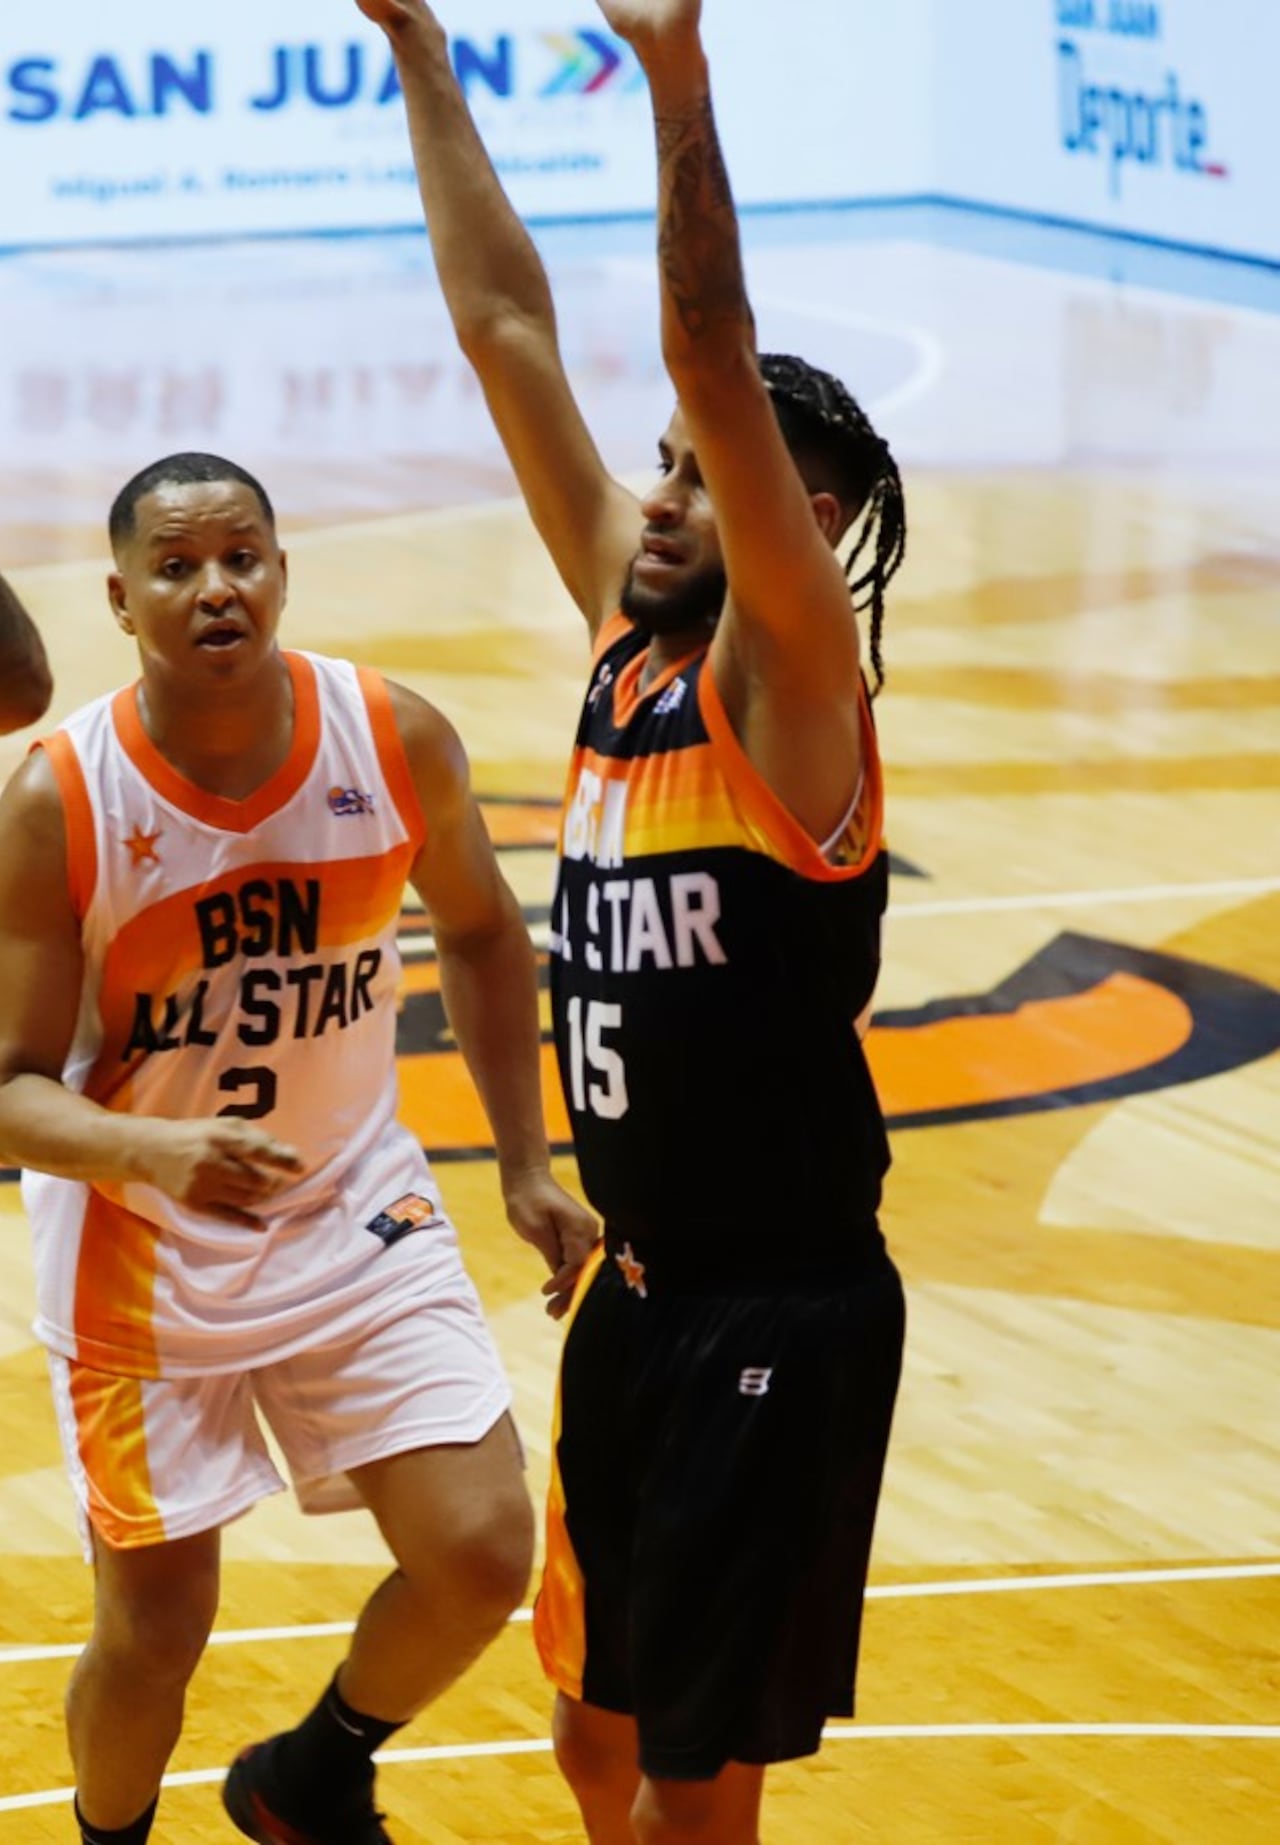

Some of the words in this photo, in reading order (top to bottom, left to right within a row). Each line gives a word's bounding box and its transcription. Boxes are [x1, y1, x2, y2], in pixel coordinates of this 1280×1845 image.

[7, 50, 211, 122] SAN
[248, 34, 513, 112] JUN
[195, 879, 321, 970] BSN
[122, 980, 217, 1061] ALL
[237, 948, 381, 1047] STAR
[216, 1066, 278, 1120] 2
[567, 996, 629, 1120] 15
